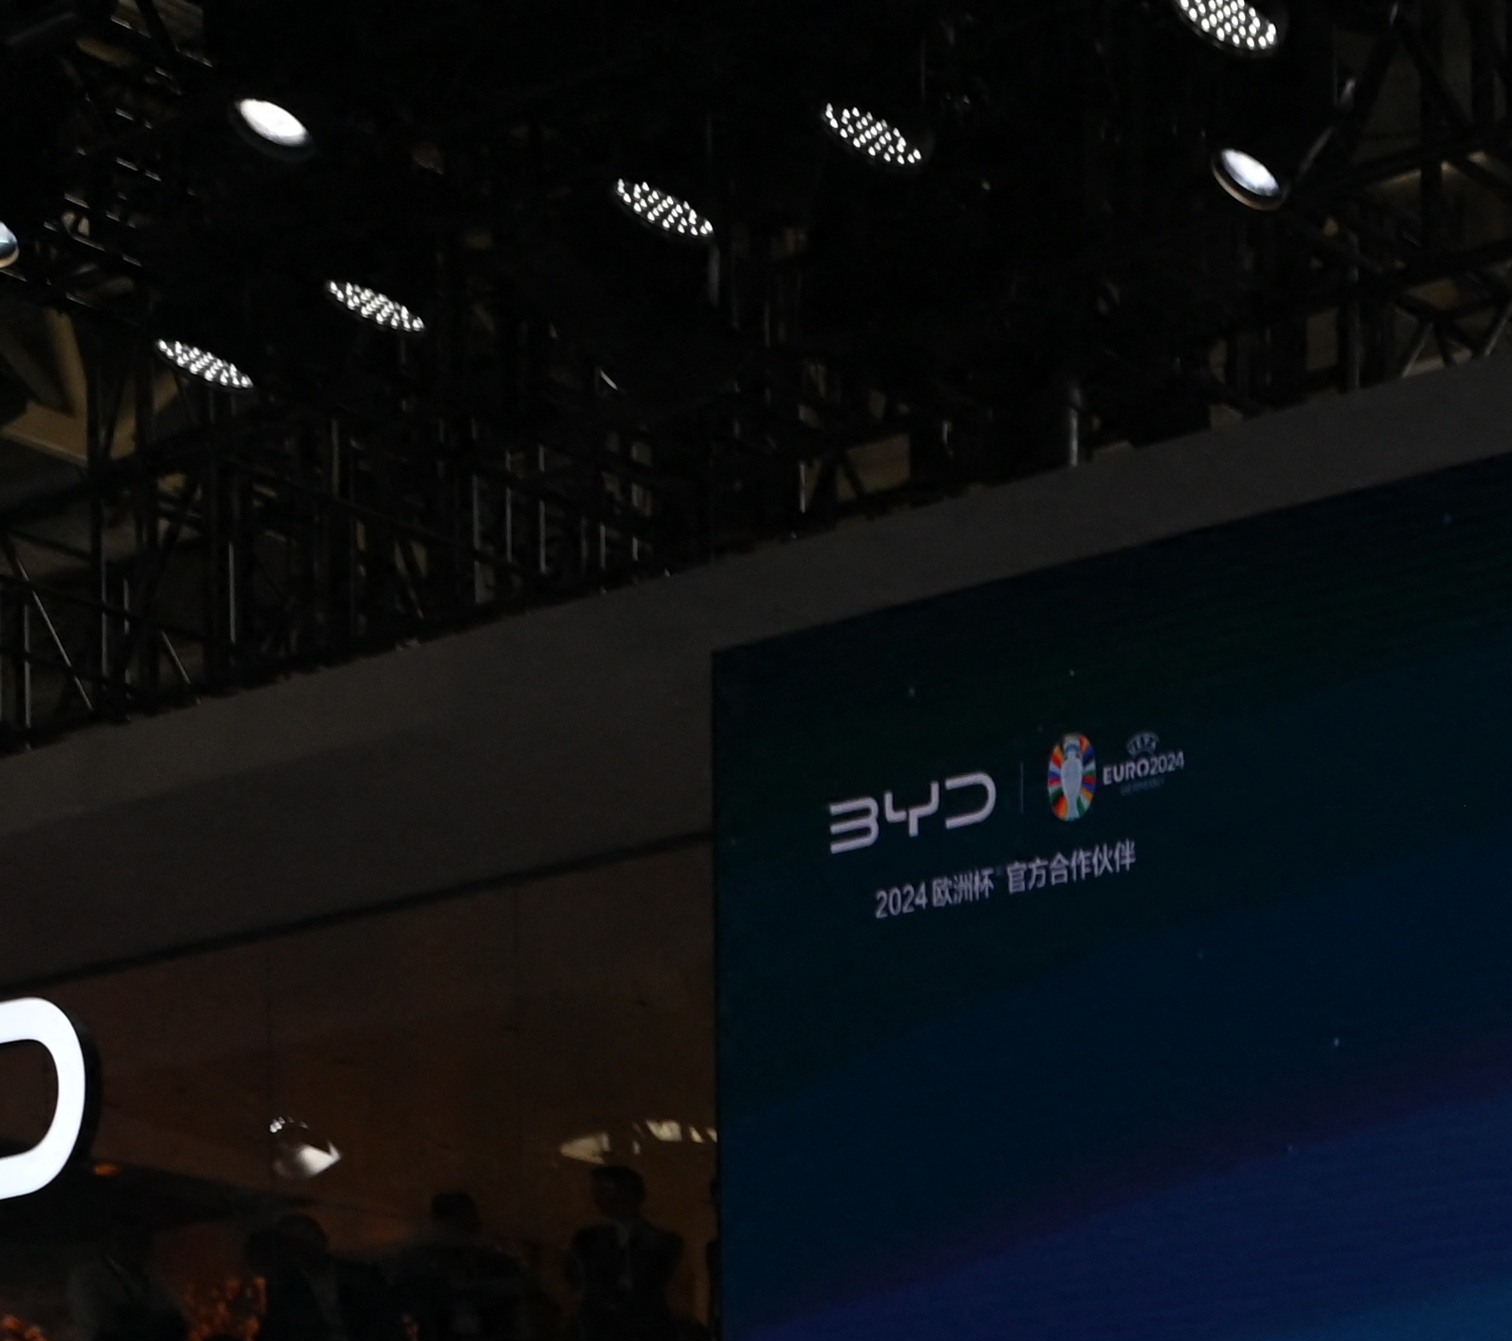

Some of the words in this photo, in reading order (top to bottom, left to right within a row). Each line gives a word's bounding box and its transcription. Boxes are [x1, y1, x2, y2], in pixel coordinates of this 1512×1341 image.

[829, 771, 997, 854] BYD
[1006, 838, 1136, 895] 官方合作伙伴
